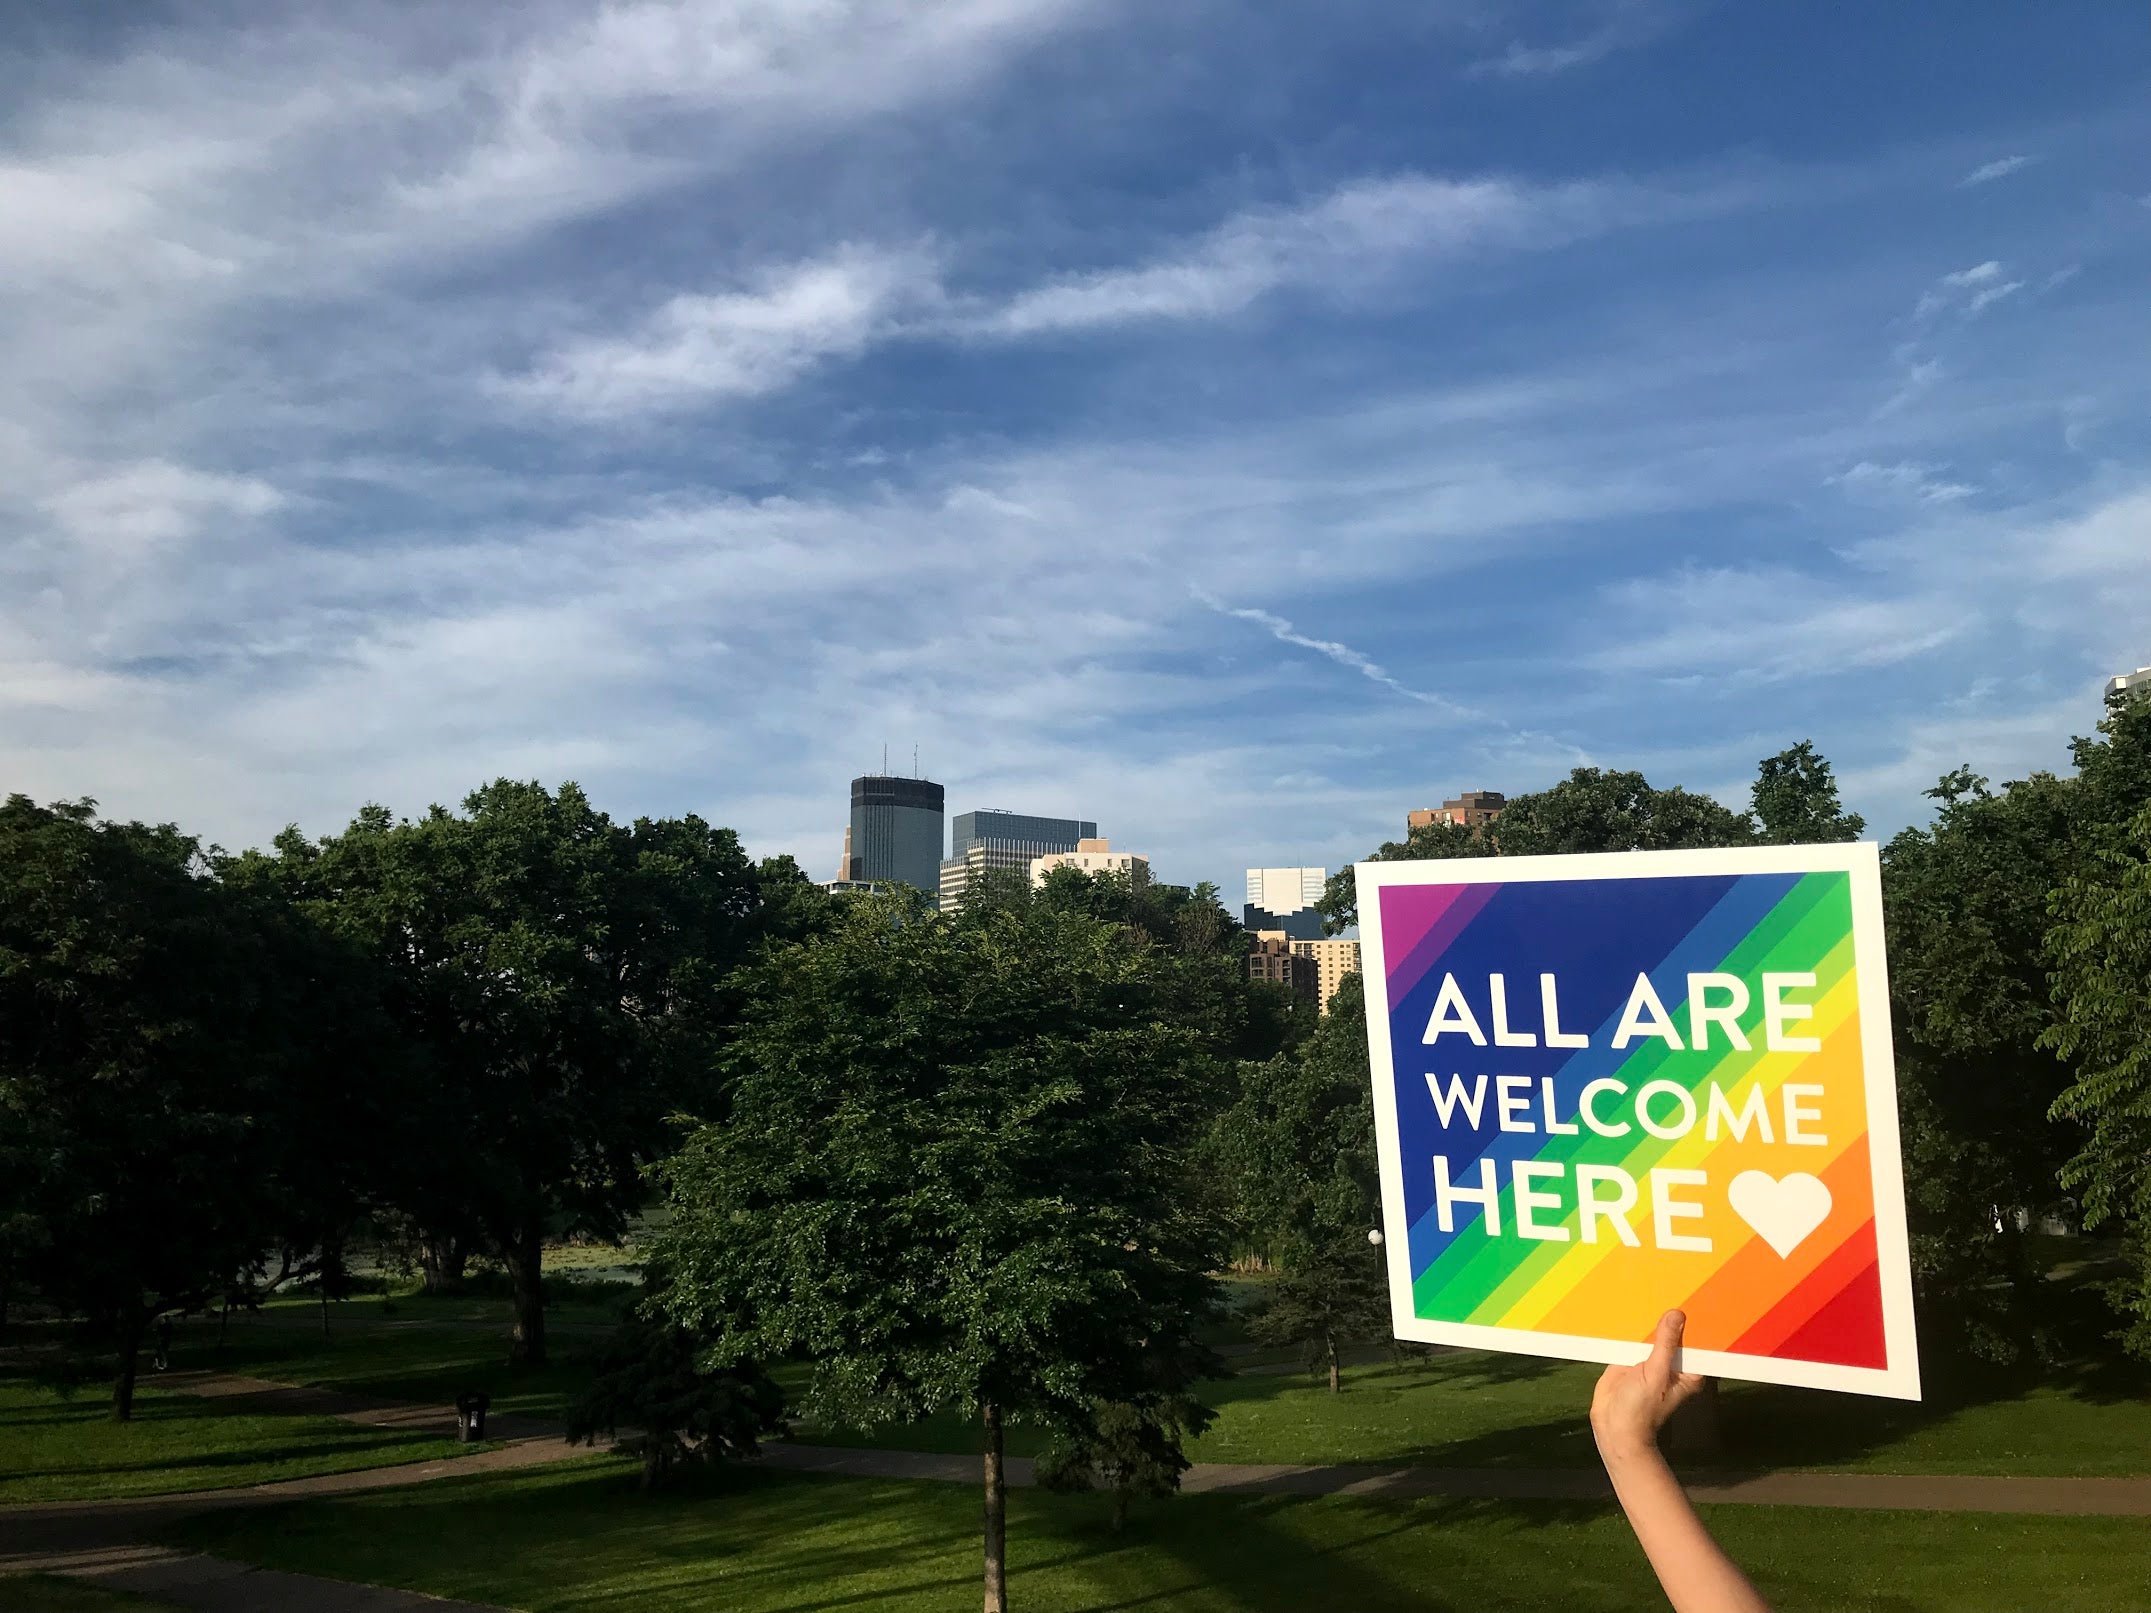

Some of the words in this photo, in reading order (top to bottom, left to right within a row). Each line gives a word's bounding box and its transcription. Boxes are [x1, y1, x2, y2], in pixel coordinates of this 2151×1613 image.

[1421, 971, 1589, 1049] ALL
[1610, 971, 1822, 1052] ARE
[1424, 1072, 1828, 1146] WELCOME
[1432, 1155, 1713, 1253] HERE
